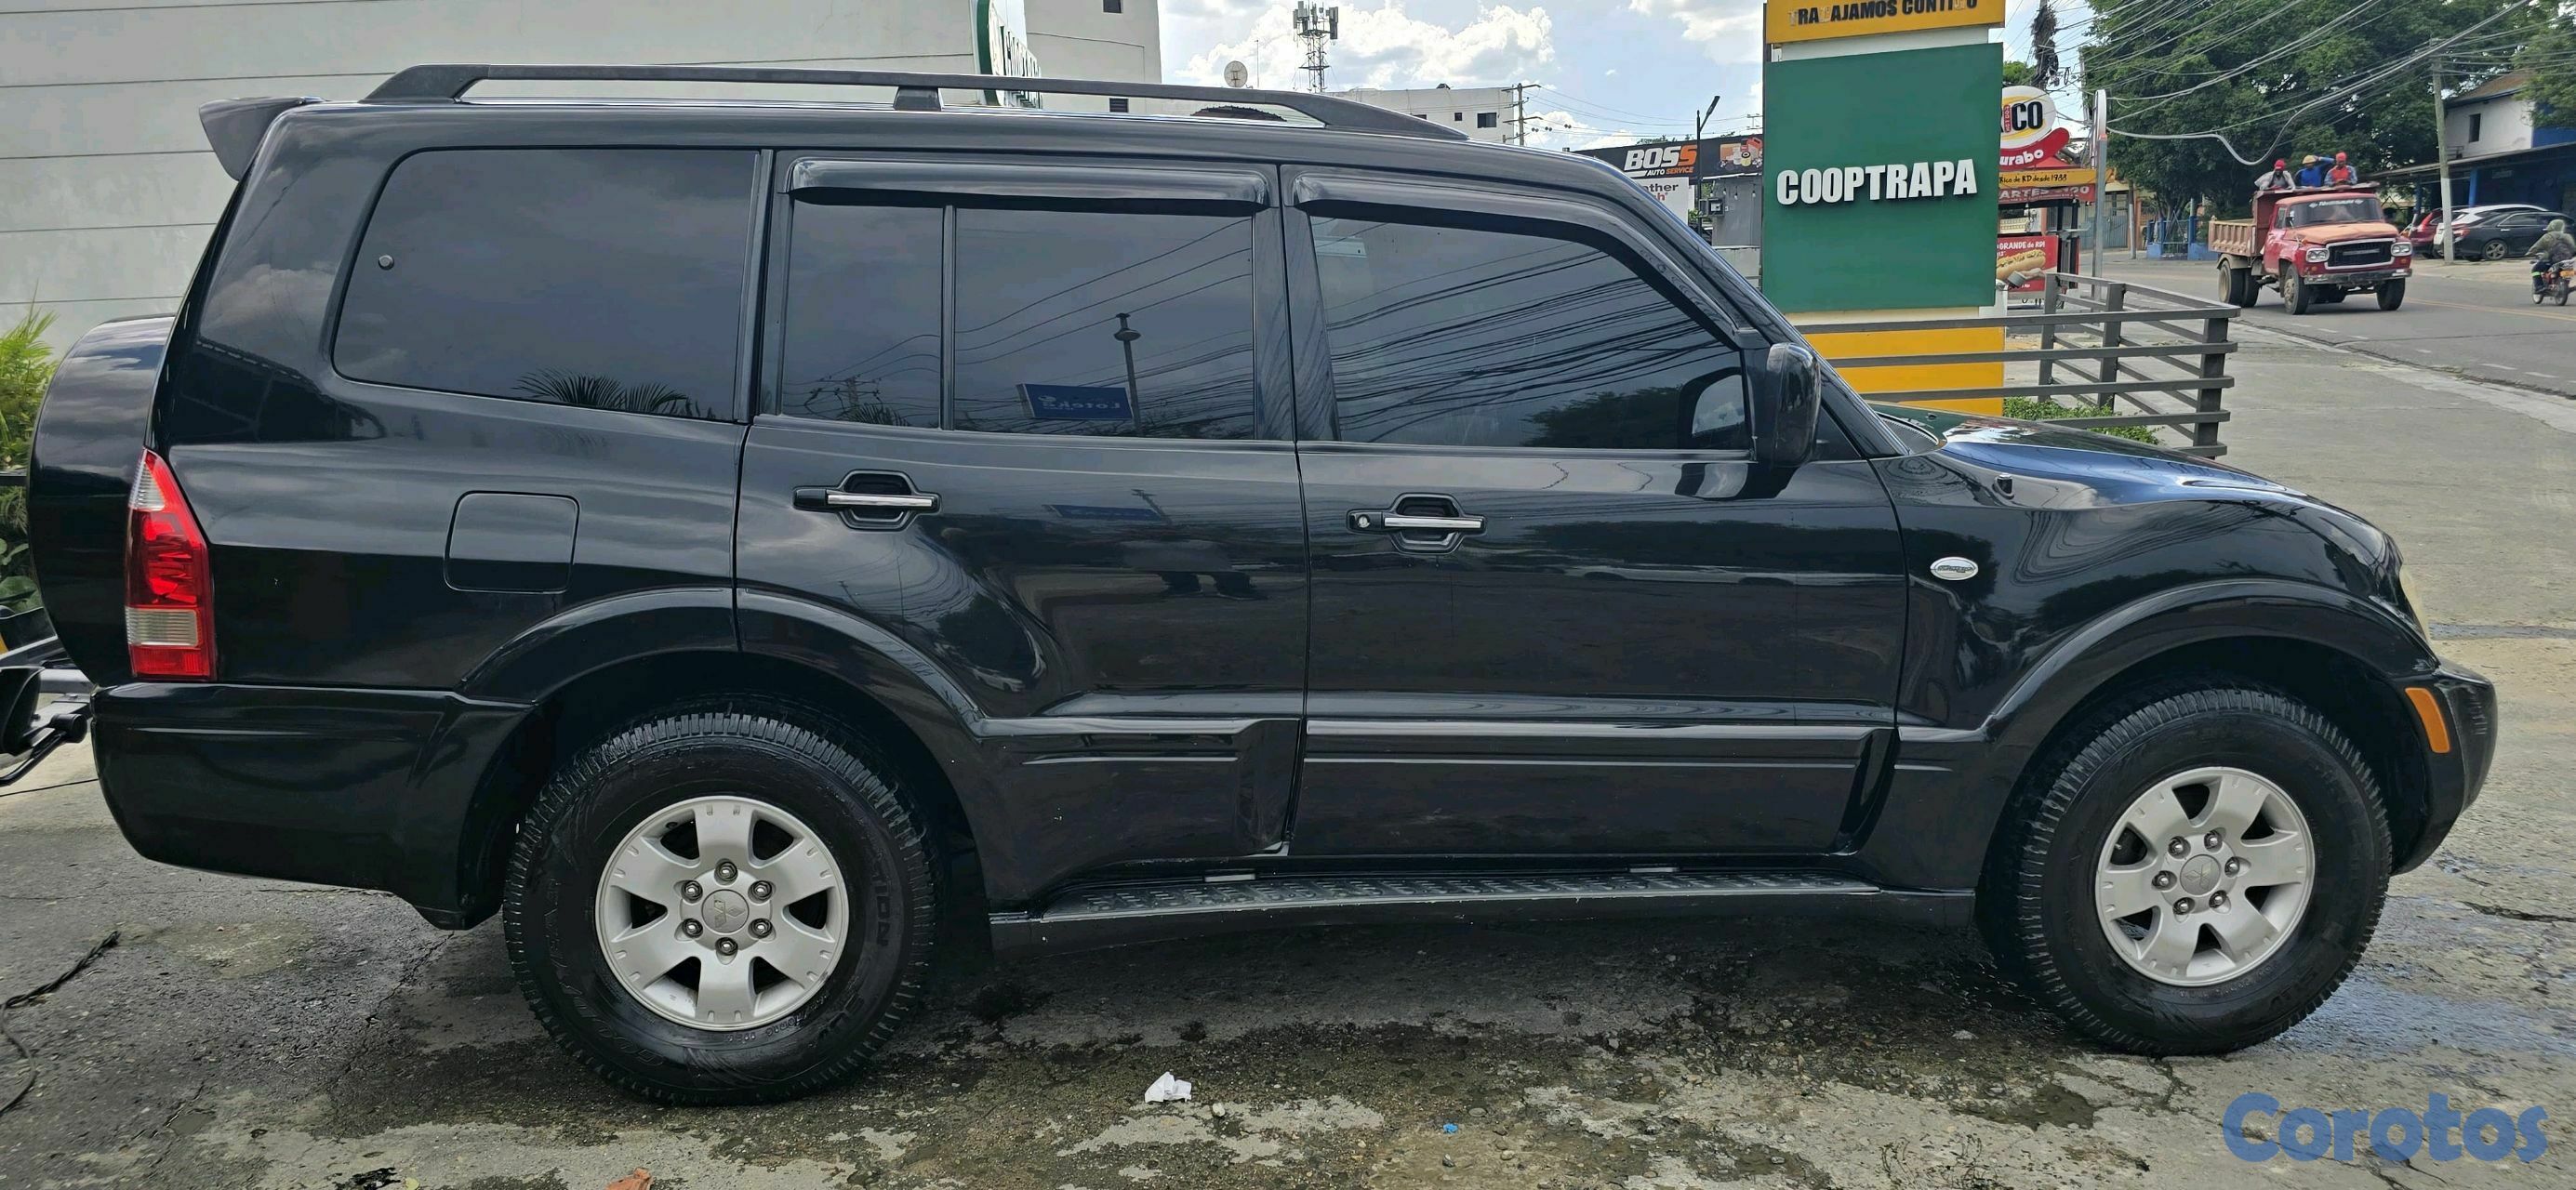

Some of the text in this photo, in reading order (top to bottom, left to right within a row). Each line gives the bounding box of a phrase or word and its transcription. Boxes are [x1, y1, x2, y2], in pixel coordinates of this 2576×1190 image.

[1624, 145, 1697, 170] BOSS
[1999, 149, 2044, 165] urabo
[1776, 158, 1978, 205] COOPTRAPA
[1999, 188, 2050, 199] ARTES
[1999, 242, 2026, 250] GRANDE
